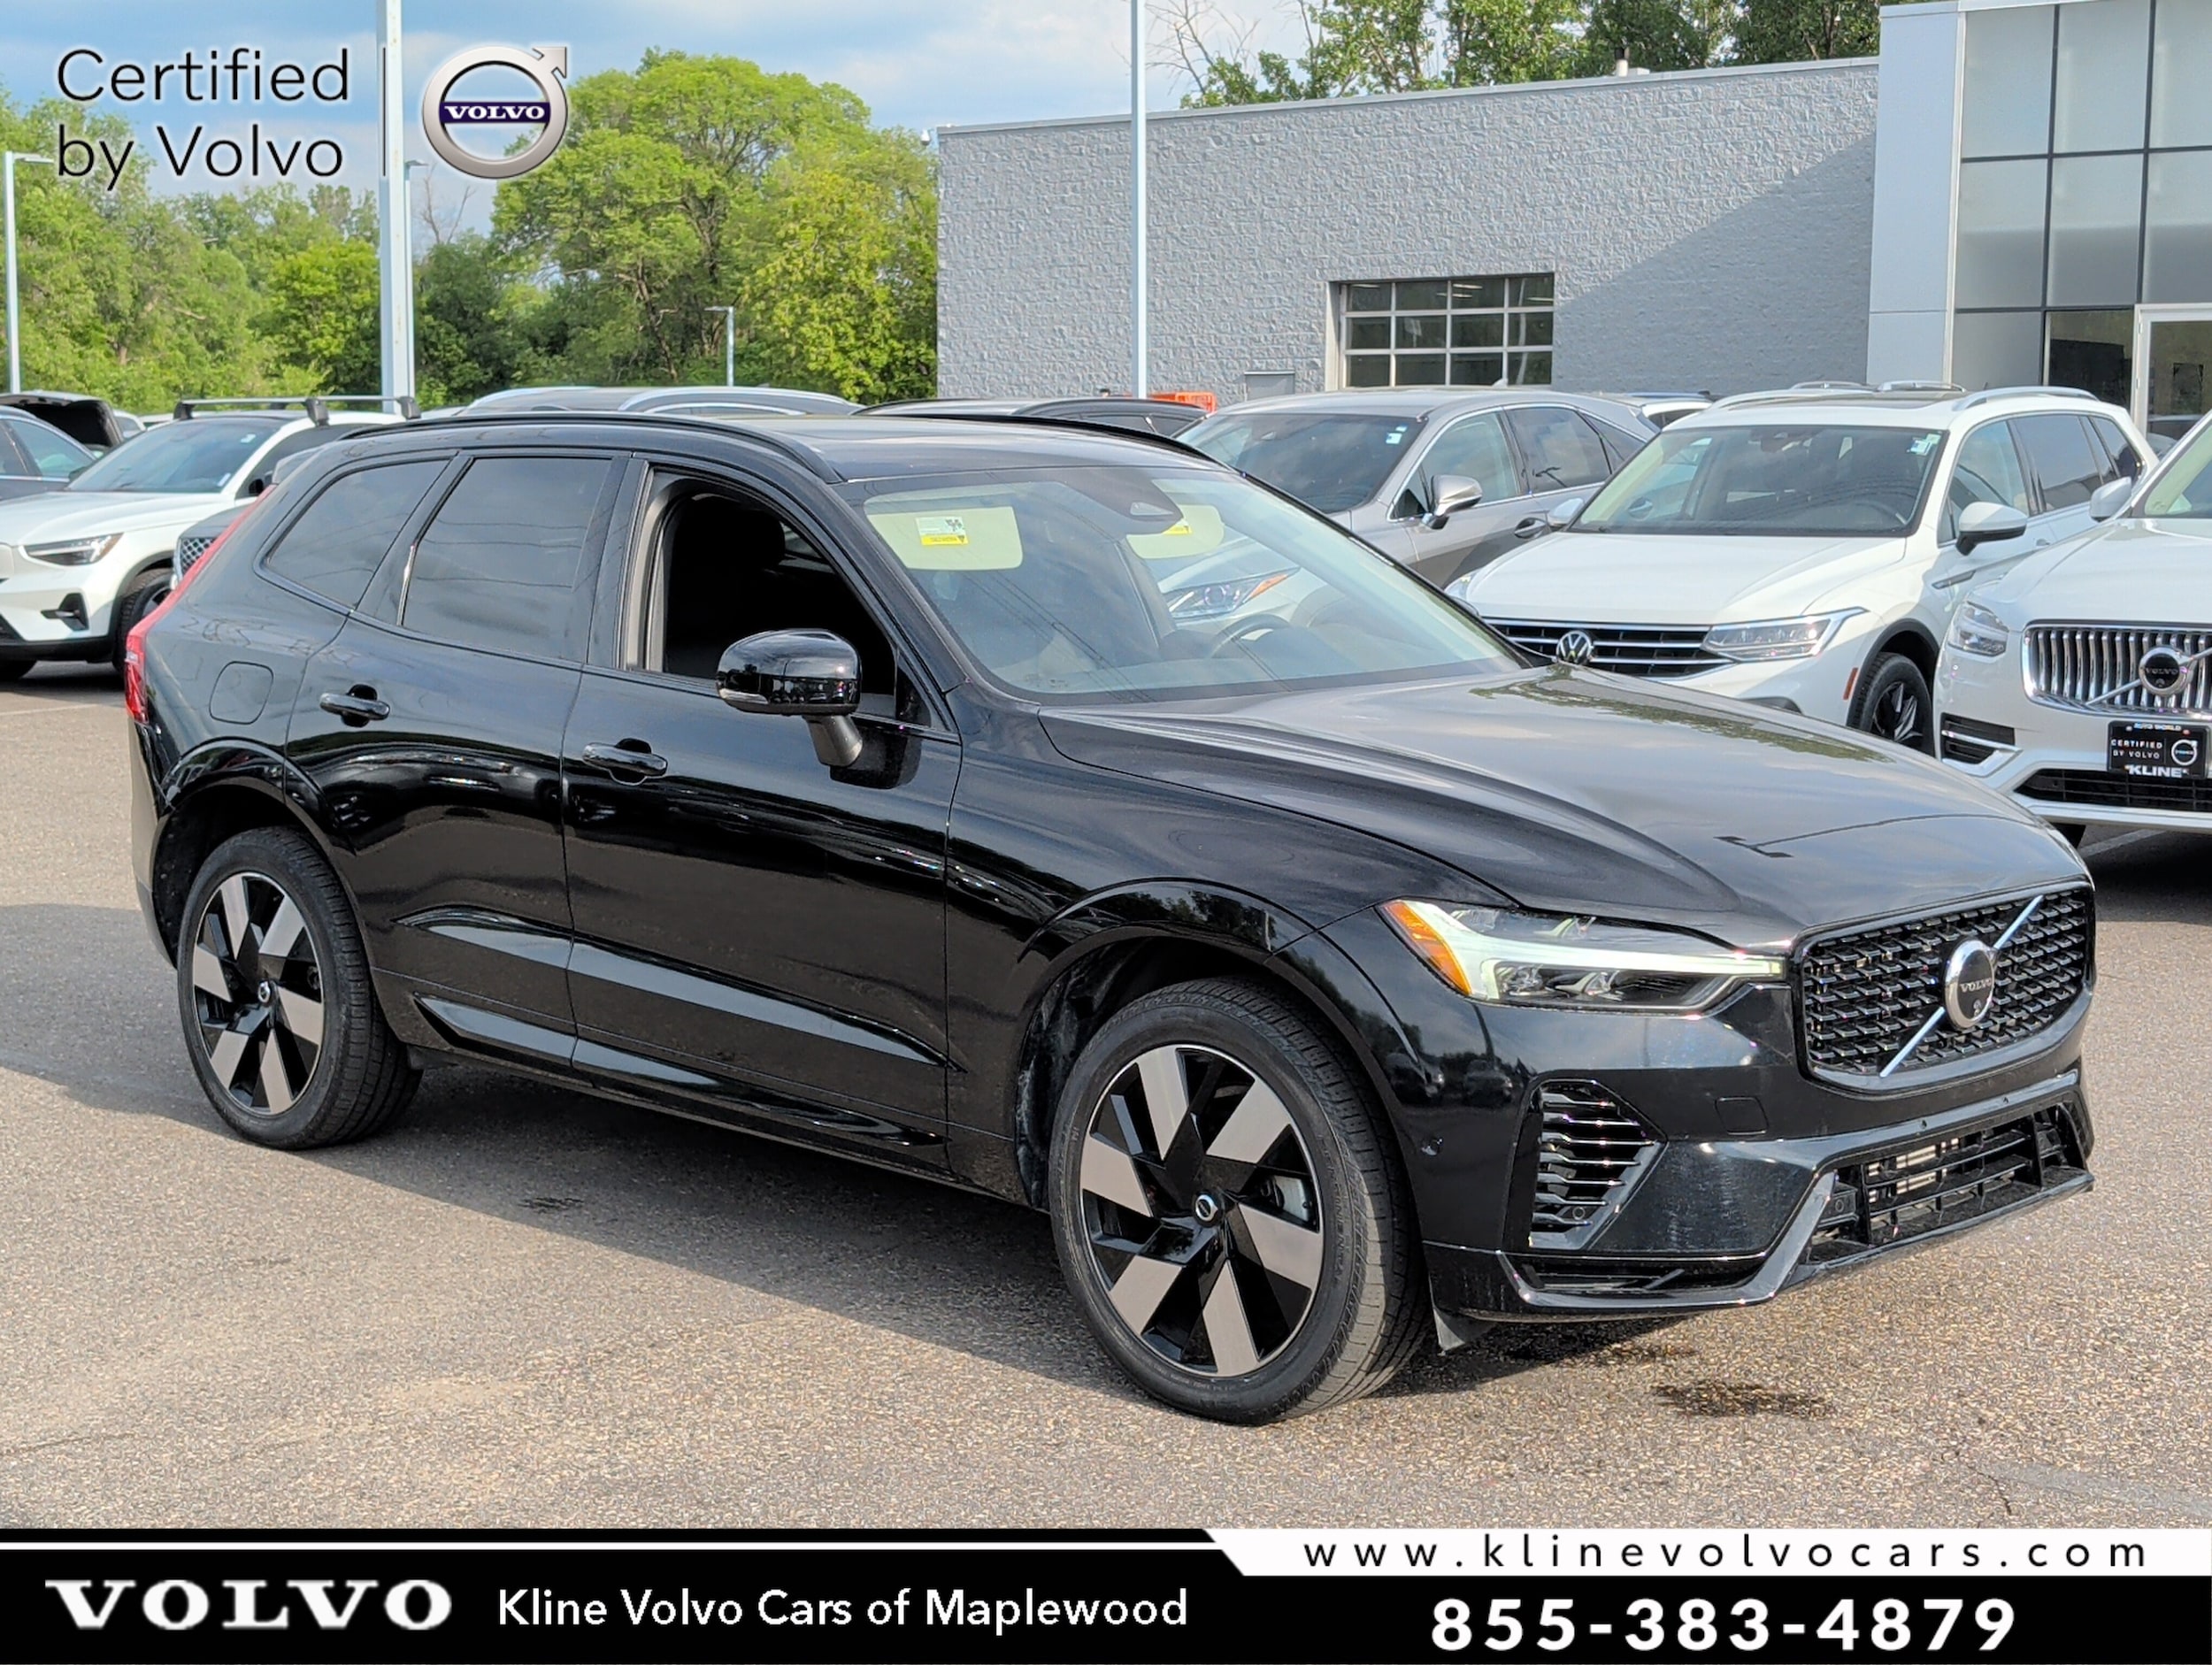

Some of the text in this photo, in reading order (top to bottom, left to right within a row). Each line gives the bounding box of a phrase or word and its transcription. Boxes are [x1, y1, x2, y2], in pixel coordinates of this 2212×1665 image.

[2111, 739, 2162, 749] CERTIFIED
[2128, 764, 2183, 778] KLINE
[1960, 978, 1992, 993] VOLVO
